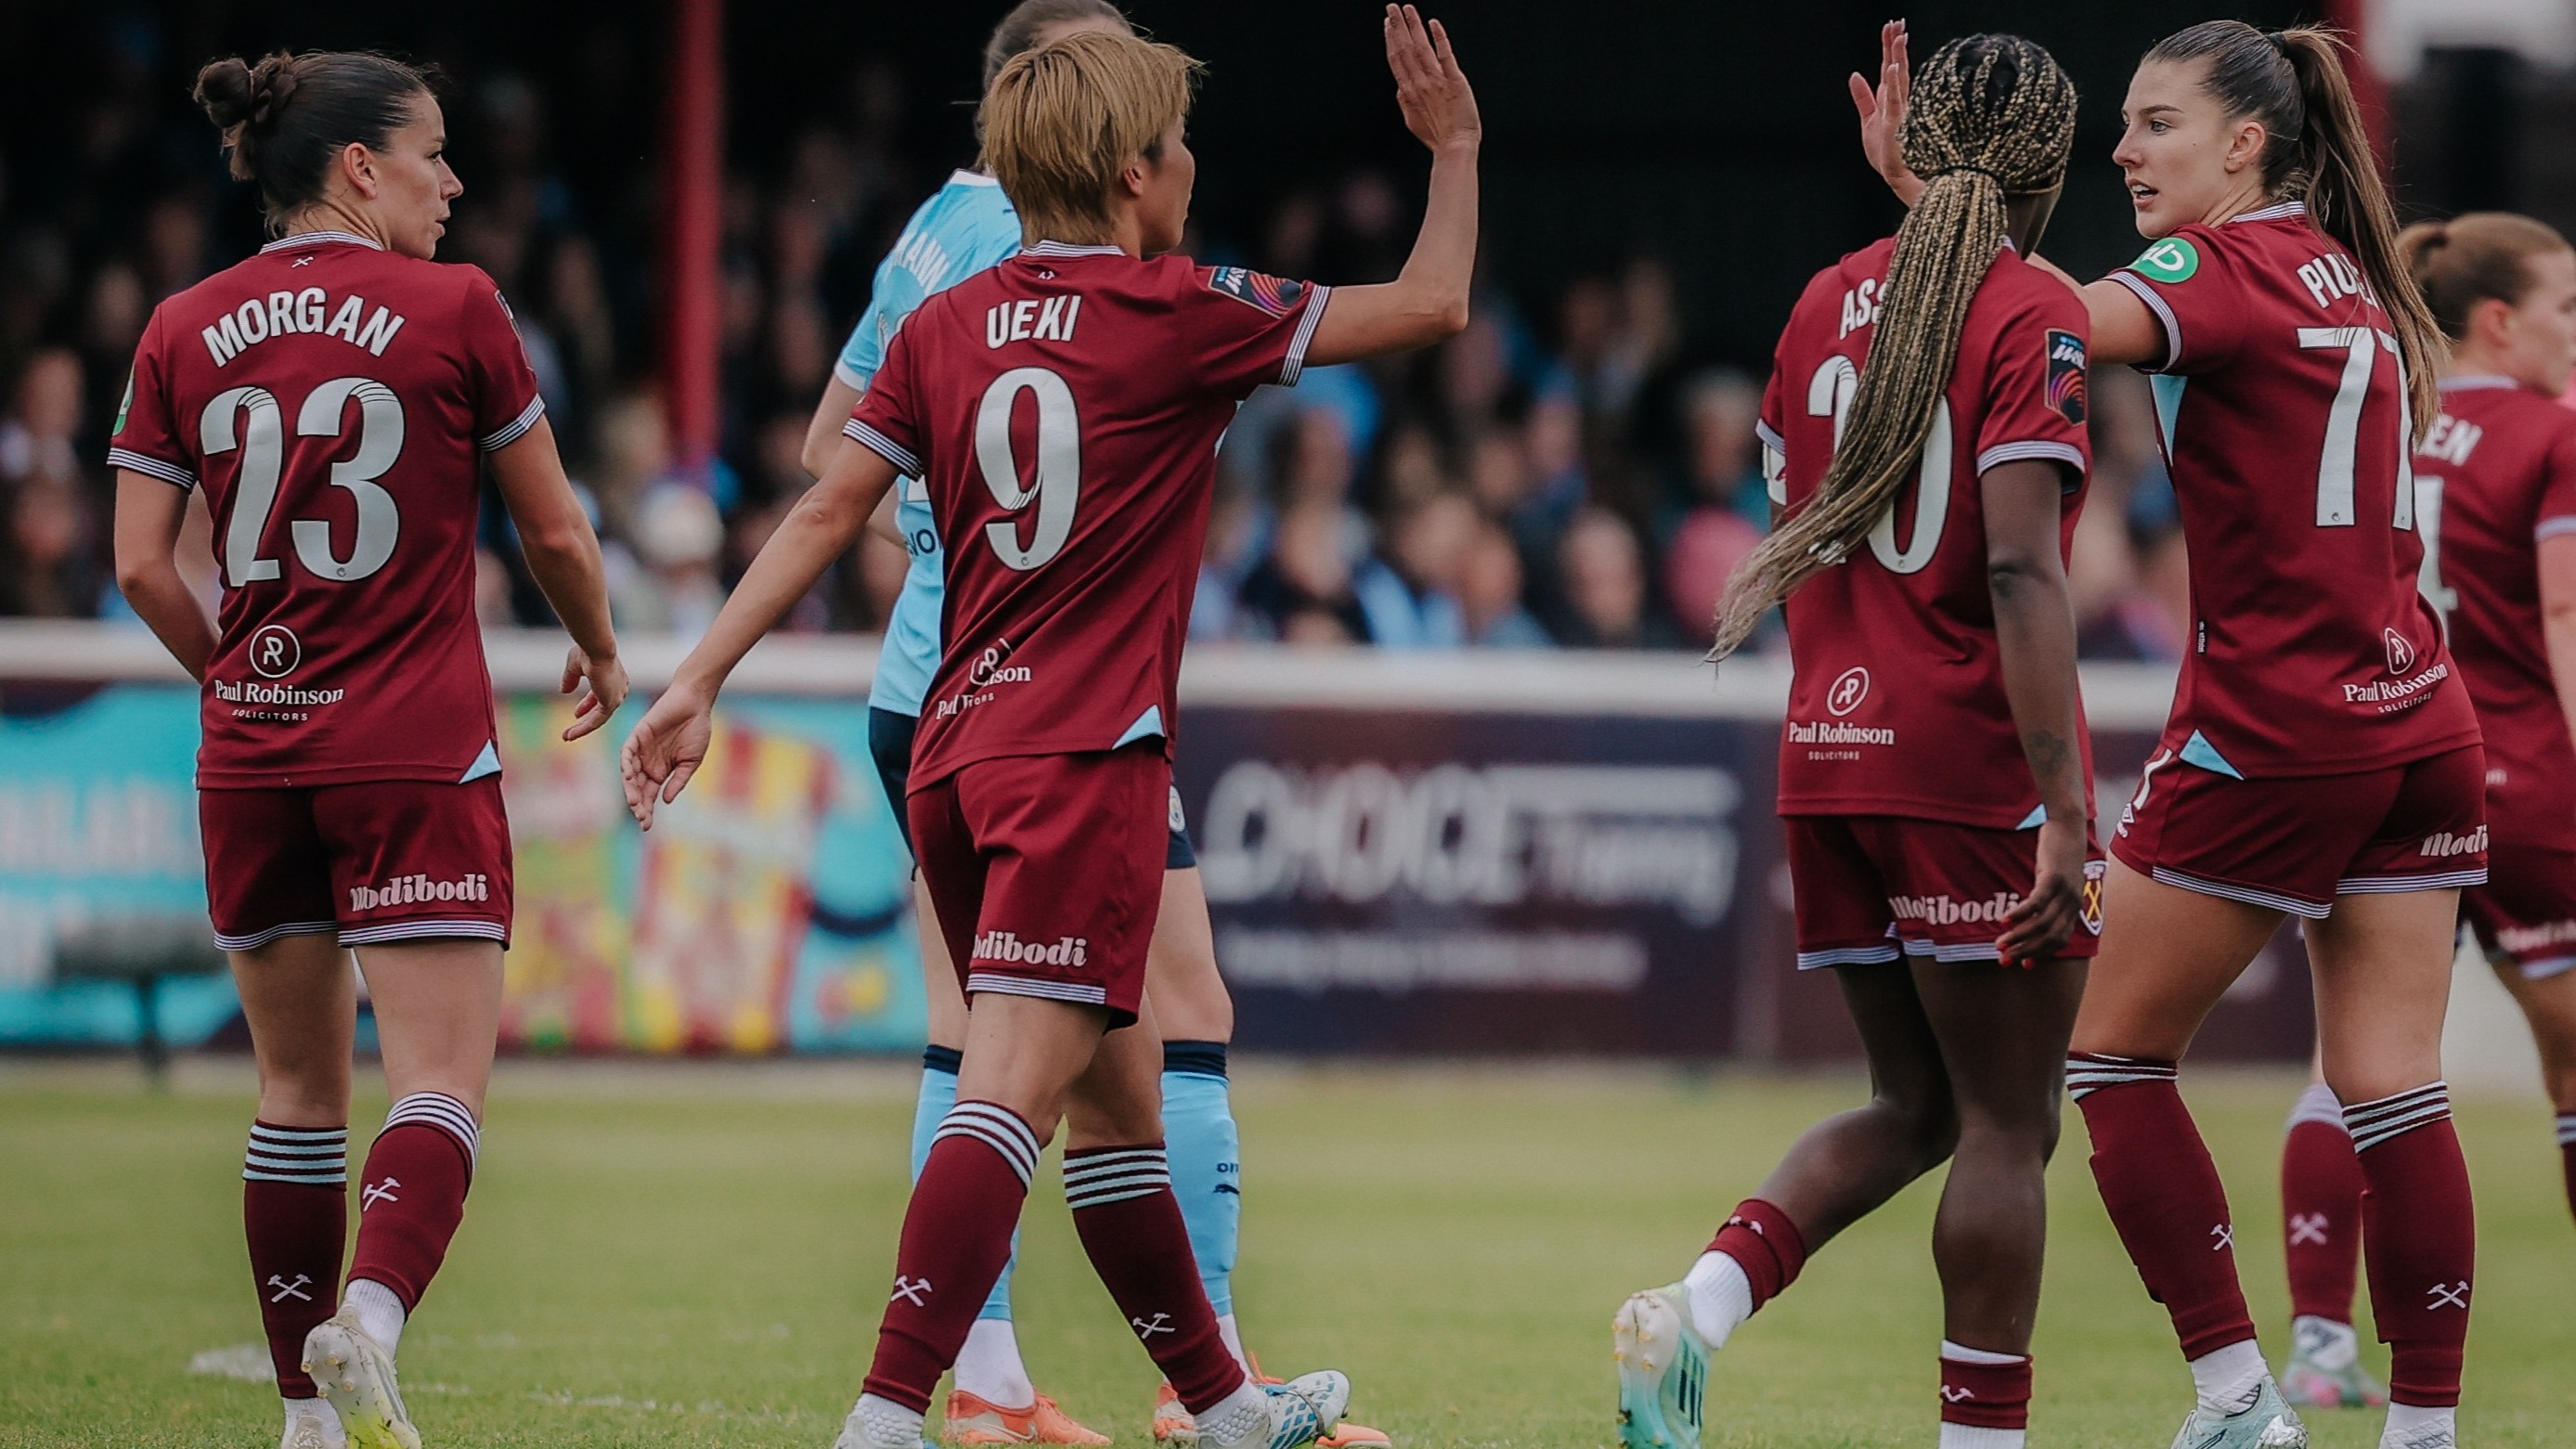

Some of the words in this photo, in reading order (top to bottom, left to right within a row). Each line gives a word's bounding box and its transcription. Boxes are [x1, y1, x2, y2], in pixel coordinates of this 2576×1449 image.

[201, 287, 406, 369] MORGAN
[986, 294, 1081, 351] UEKI
[2415, 414, 2483, 466] EN
[200, 376, 406, 588] 23
[974, 367, 1082, 572] 9
[214, 679, 241, 702] Paul
[244, 682, 344, 705] Robinson
[2342, 680, 2380, 702] Paul
[2378, 663, 2449, 701] Robinson
[2377, 692, 2433, 714] SOLICITORS
[232, 708, 309, 721] SOLICITORS
[1788, 720, 1818, 744] Paul
[1818, 720, 1896, 745] Robinson
